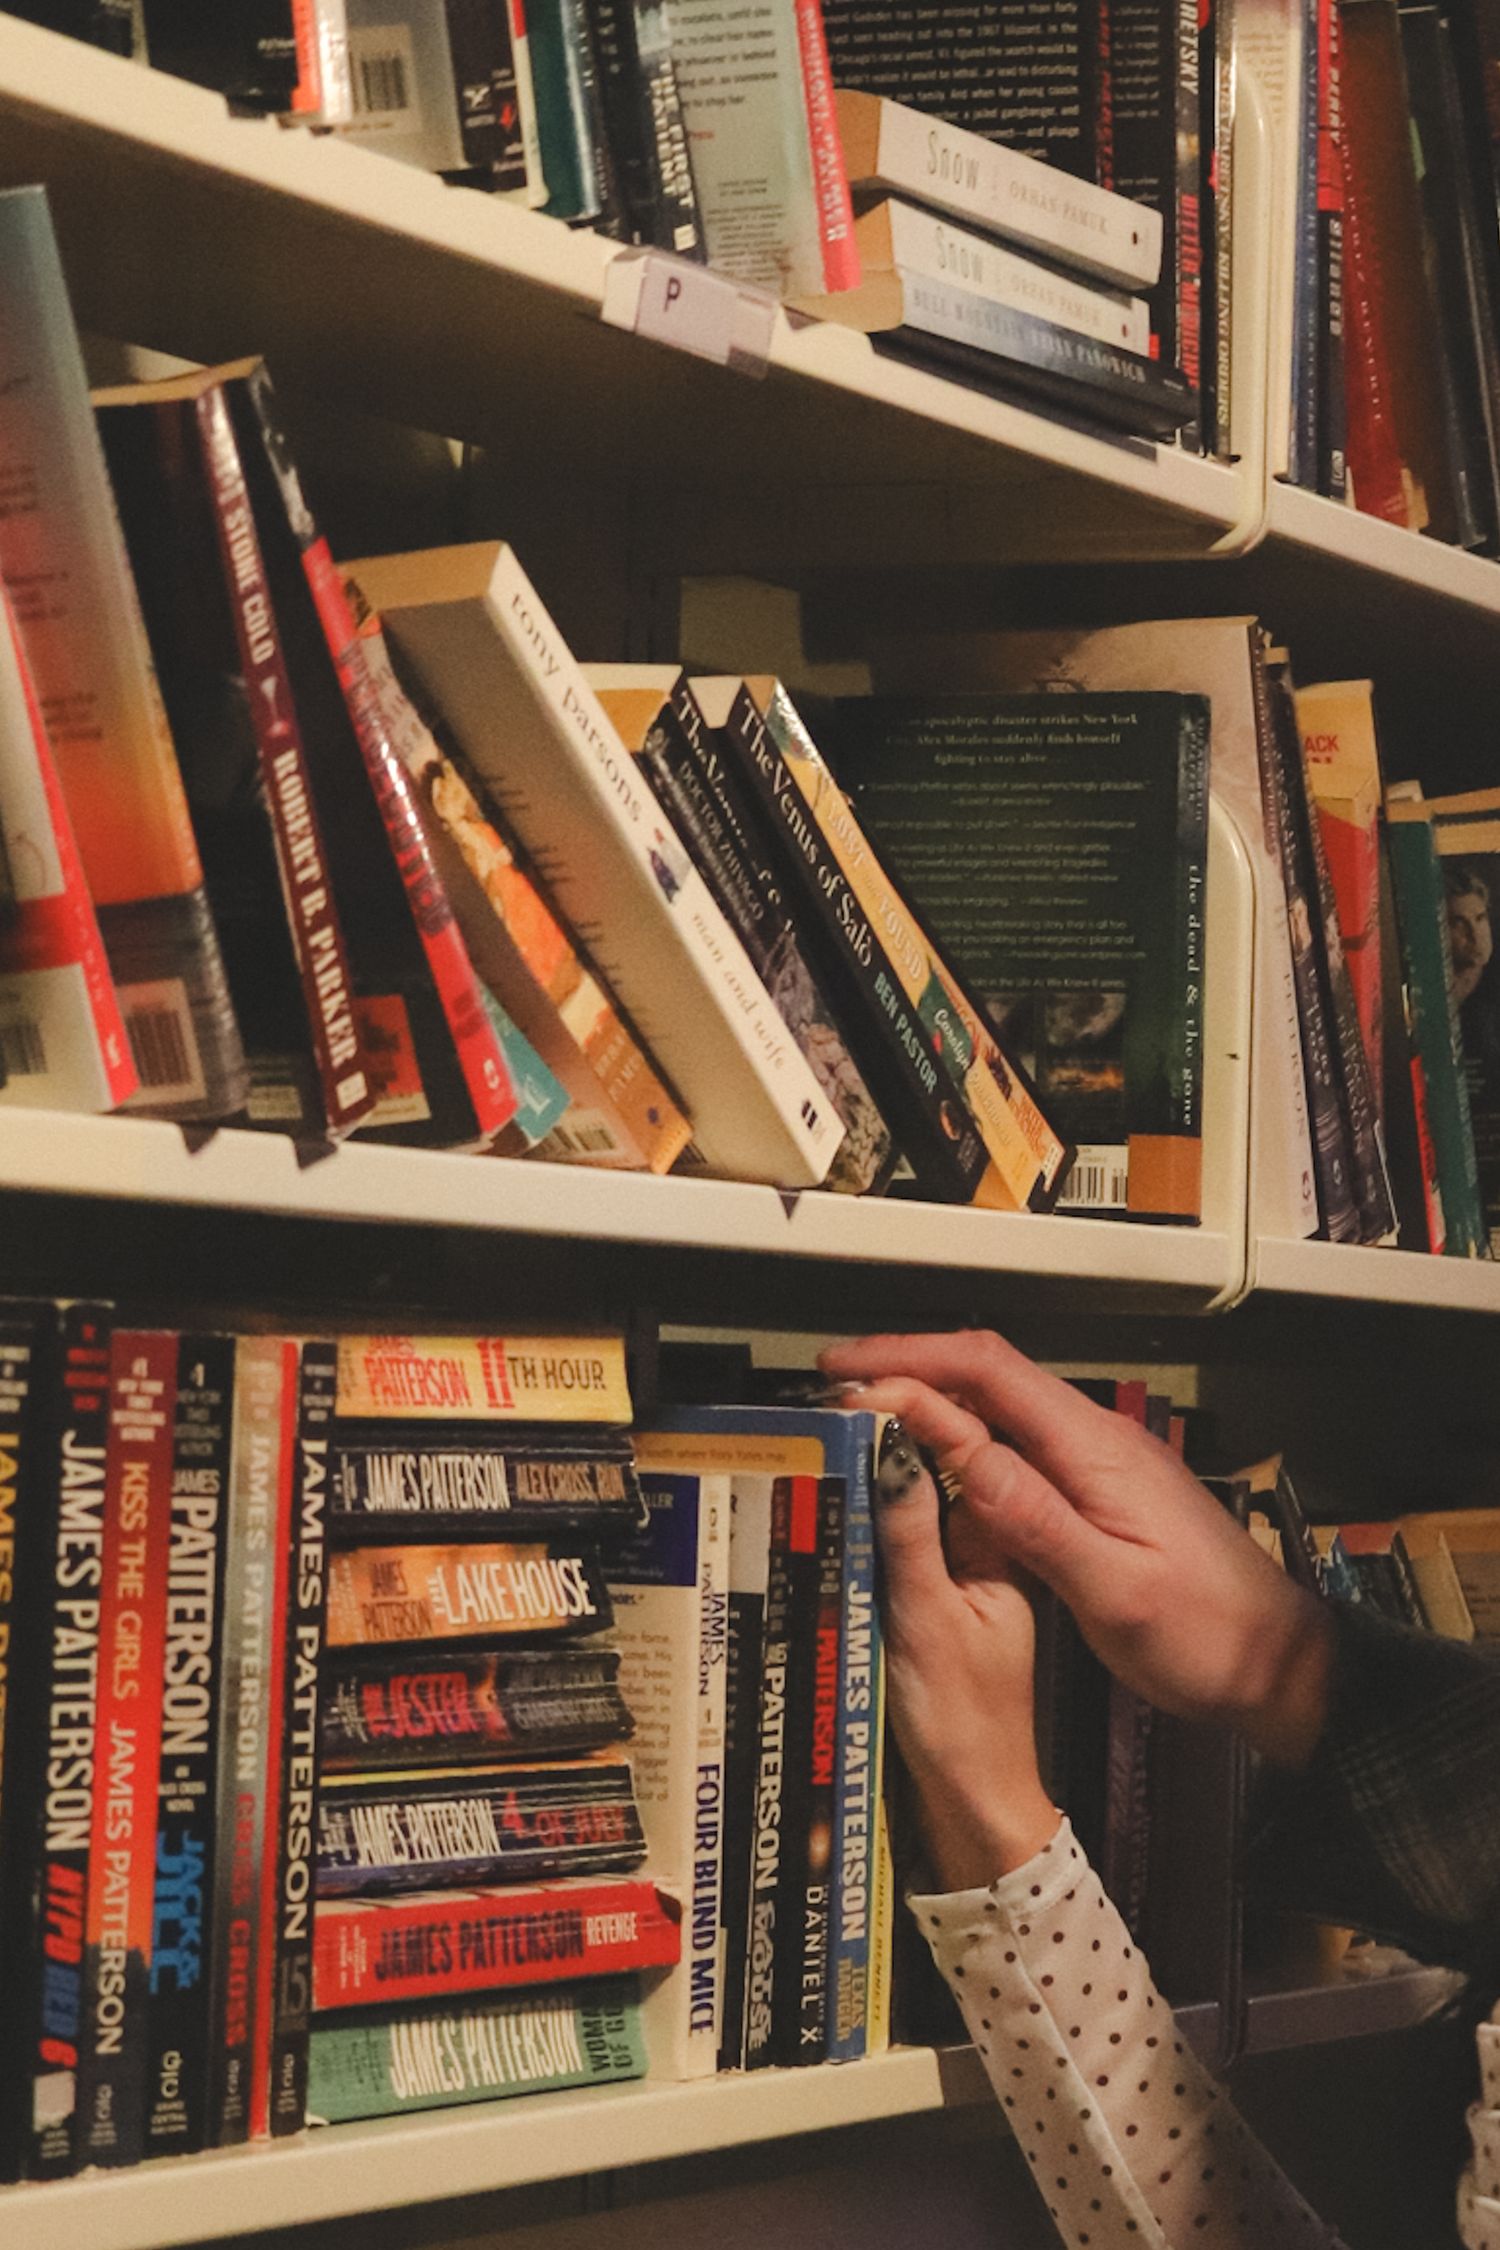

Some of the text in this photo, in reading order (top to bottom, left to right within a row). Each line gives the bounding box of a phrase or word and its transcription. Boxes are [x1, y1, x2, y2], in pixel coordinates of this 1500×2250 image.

[816, 131, 848, 242] PALMER
[1217, 129, 1230, 237] PARETSKY
[1328, 67, 1343, 337] PERRY Silence
[1180, 195, 1198, 273] BITTER
[663, 277, 682, 312] P
[1217, 253, 1230, 339] KILLING
[1077, 340, 1146, 383] PANOWICH
[1216, 340, 1229, 427] ORDERS
[223, 506, 259, 594] STONE
[242, 600, 276, 665] COLD
[992, 715, 1036, 724] disaster
[1040, 714, 1080, 724] strikes
[1083, 714, 1107, 724] New
[1111, 714, 1138, 724] York
[992, 735, 1042, 747] suddenly
[1076, 733, 1121, 744] himself
[1304, 735, 1339, 752] ACK
[272, 749, 326, 897] ROBERT
[506, 591, 789, 1070] tony parsons man and wife
[680, 763, 764, 919] DOCTOR ZHIVAGO
[299, 894, 329, 927] B.
[732, 700, 777, 766] The
[764, 768, 829, 863] Venus
[817, 862, 845, 894] of
[869, 974, 904, 1019] BEN
[894, 1018, 942, 1092] PASTOR
[872, 897, 925, 979] FOUND
[307, 927, 360, 1069] PARKER
[935, 1009, 972, 1069] Carolyn
[1182, 864, 1201, 1127] the dead & the gone
[363, 1355, 473, 1409] PATTERSON
[544, 1357, 607, 1391] HOUR
[55, 1429, 108, 1589] JAMES
[120, 1461, 151, 1532] KISS
[172, 1468, 221, 1494] JAMES
[246, 1432, 272, 1553] JAMES
[297, 1439, 328, 1609] JAMES
[363, 1454, 420, 1511] JAMES
[419, 1454, 511, 1510] PATTERSON
[117, 1538, 148, 1599] THE
[370, 1560, 408, 1599] JAMES
[440, 1558, 597, 1626] LAKE HOUSE
[112, 1610, 143, 1701] GIRLS
[161, 1496, 218, 1756] PATTERSON
[361, 1599, 432, 1642] PATTERSON
[698, 1562, 712, 1697] PATTERSON
[709, 1592, 727, 1666] JAMES
[236, 1563, 266, 1782] PATTERSON
[389, 1672, 478, 1738] JESTER
[811, 1627, 839, 1786] PATTERSON
[46, 1600, 101, 1851] PATTERSON
[840, 1580, 873, 1941] JAMES PATTERSON
[105, 1720, 137, 1841] JAMES
[284, 1624, 320, 1941] PATTERSON
[754, 1664, 787, 1890] PATTERSON
[350, 1803, 411, 1866] JAMES
[407, 1798, 502, 1863] PATTERSON
[43, 1863, 87, 1965] NYPD
[180, 1829, 205, 1948] JACK
[688, 1764, 720, 2039] FOUR BLIND MICE
[95, 1850, 132, 2055] PATTERSON
[225, 1919, 251, 2048] CROSS
[374, 1908, 638, 1981] JAMES PATTERSON REVENGE
[801, 1885, 823, 2045] DANIEL X
[582, 2006, 611, 2075] WOM
[837, 1957, 854, 2043] RANGER
[851, 1964, 866, 2030] TEXAS
[390, 1999, 584, 2099] JAMES PATTERSON
